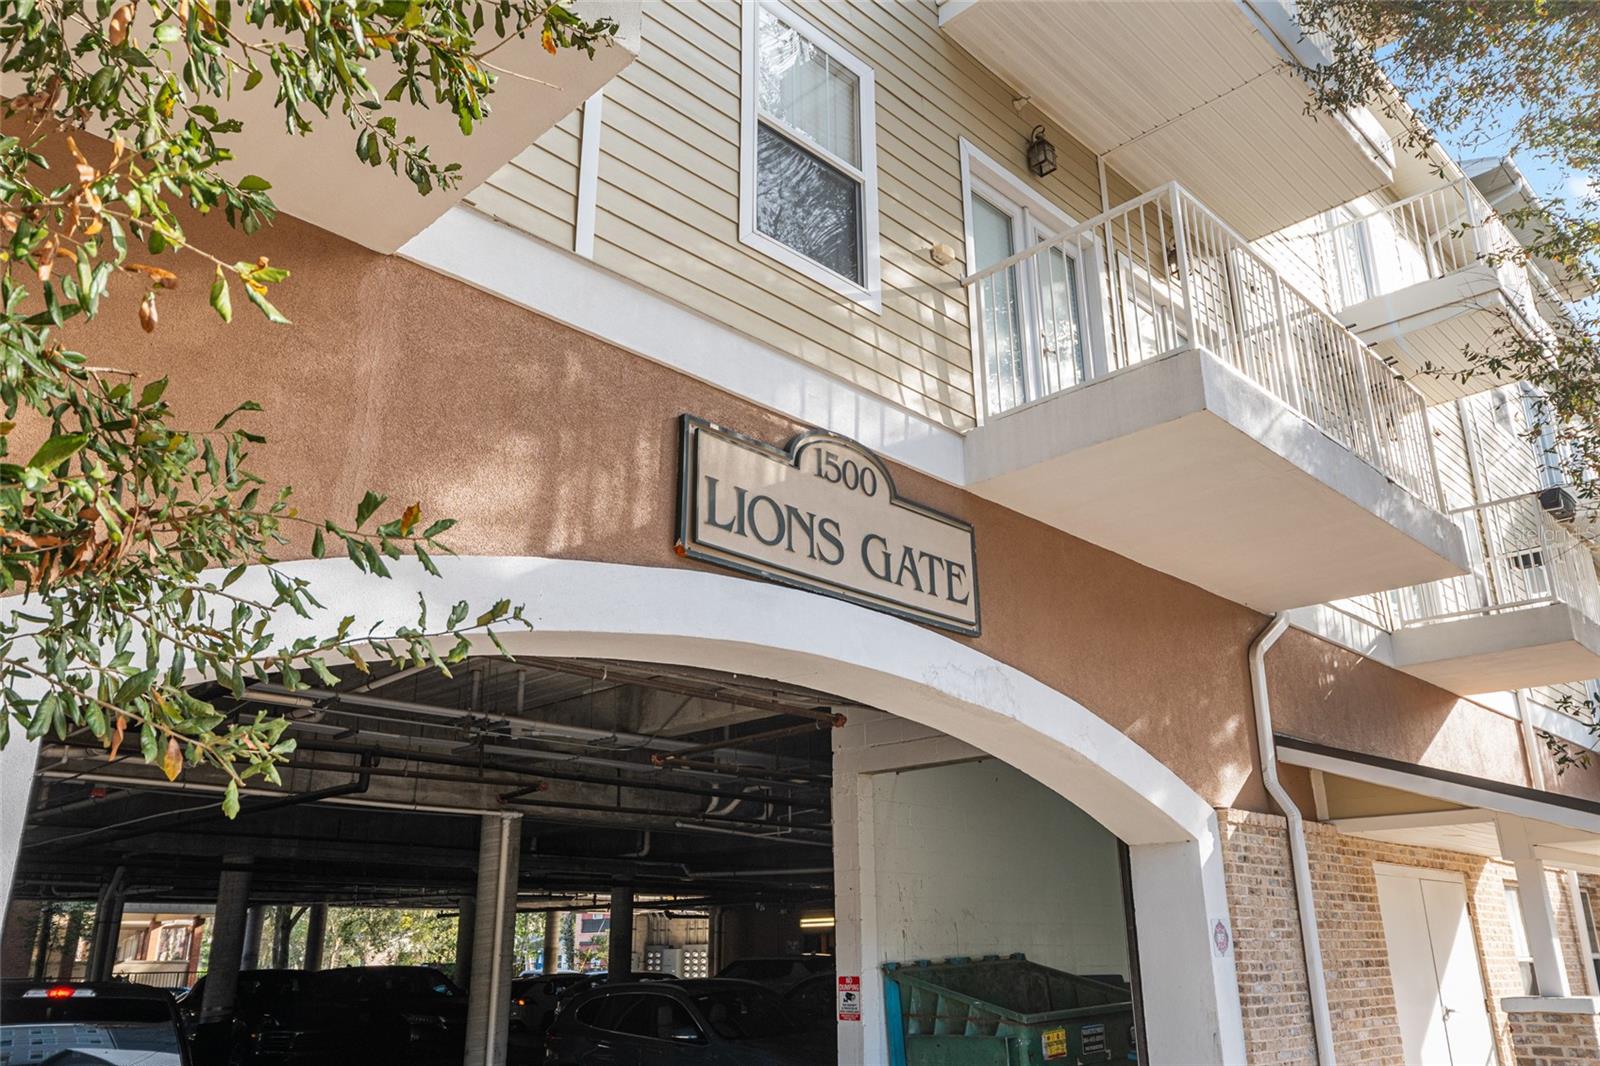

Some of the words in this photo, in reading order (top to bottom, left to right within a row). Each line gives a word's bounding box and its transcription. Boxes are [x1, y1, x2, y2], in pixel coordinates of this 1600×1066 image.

[814, 448, 877, 497] 1500
[705, 476, 845, 565] LIONS
[861, 533, 970, 606] GATE
